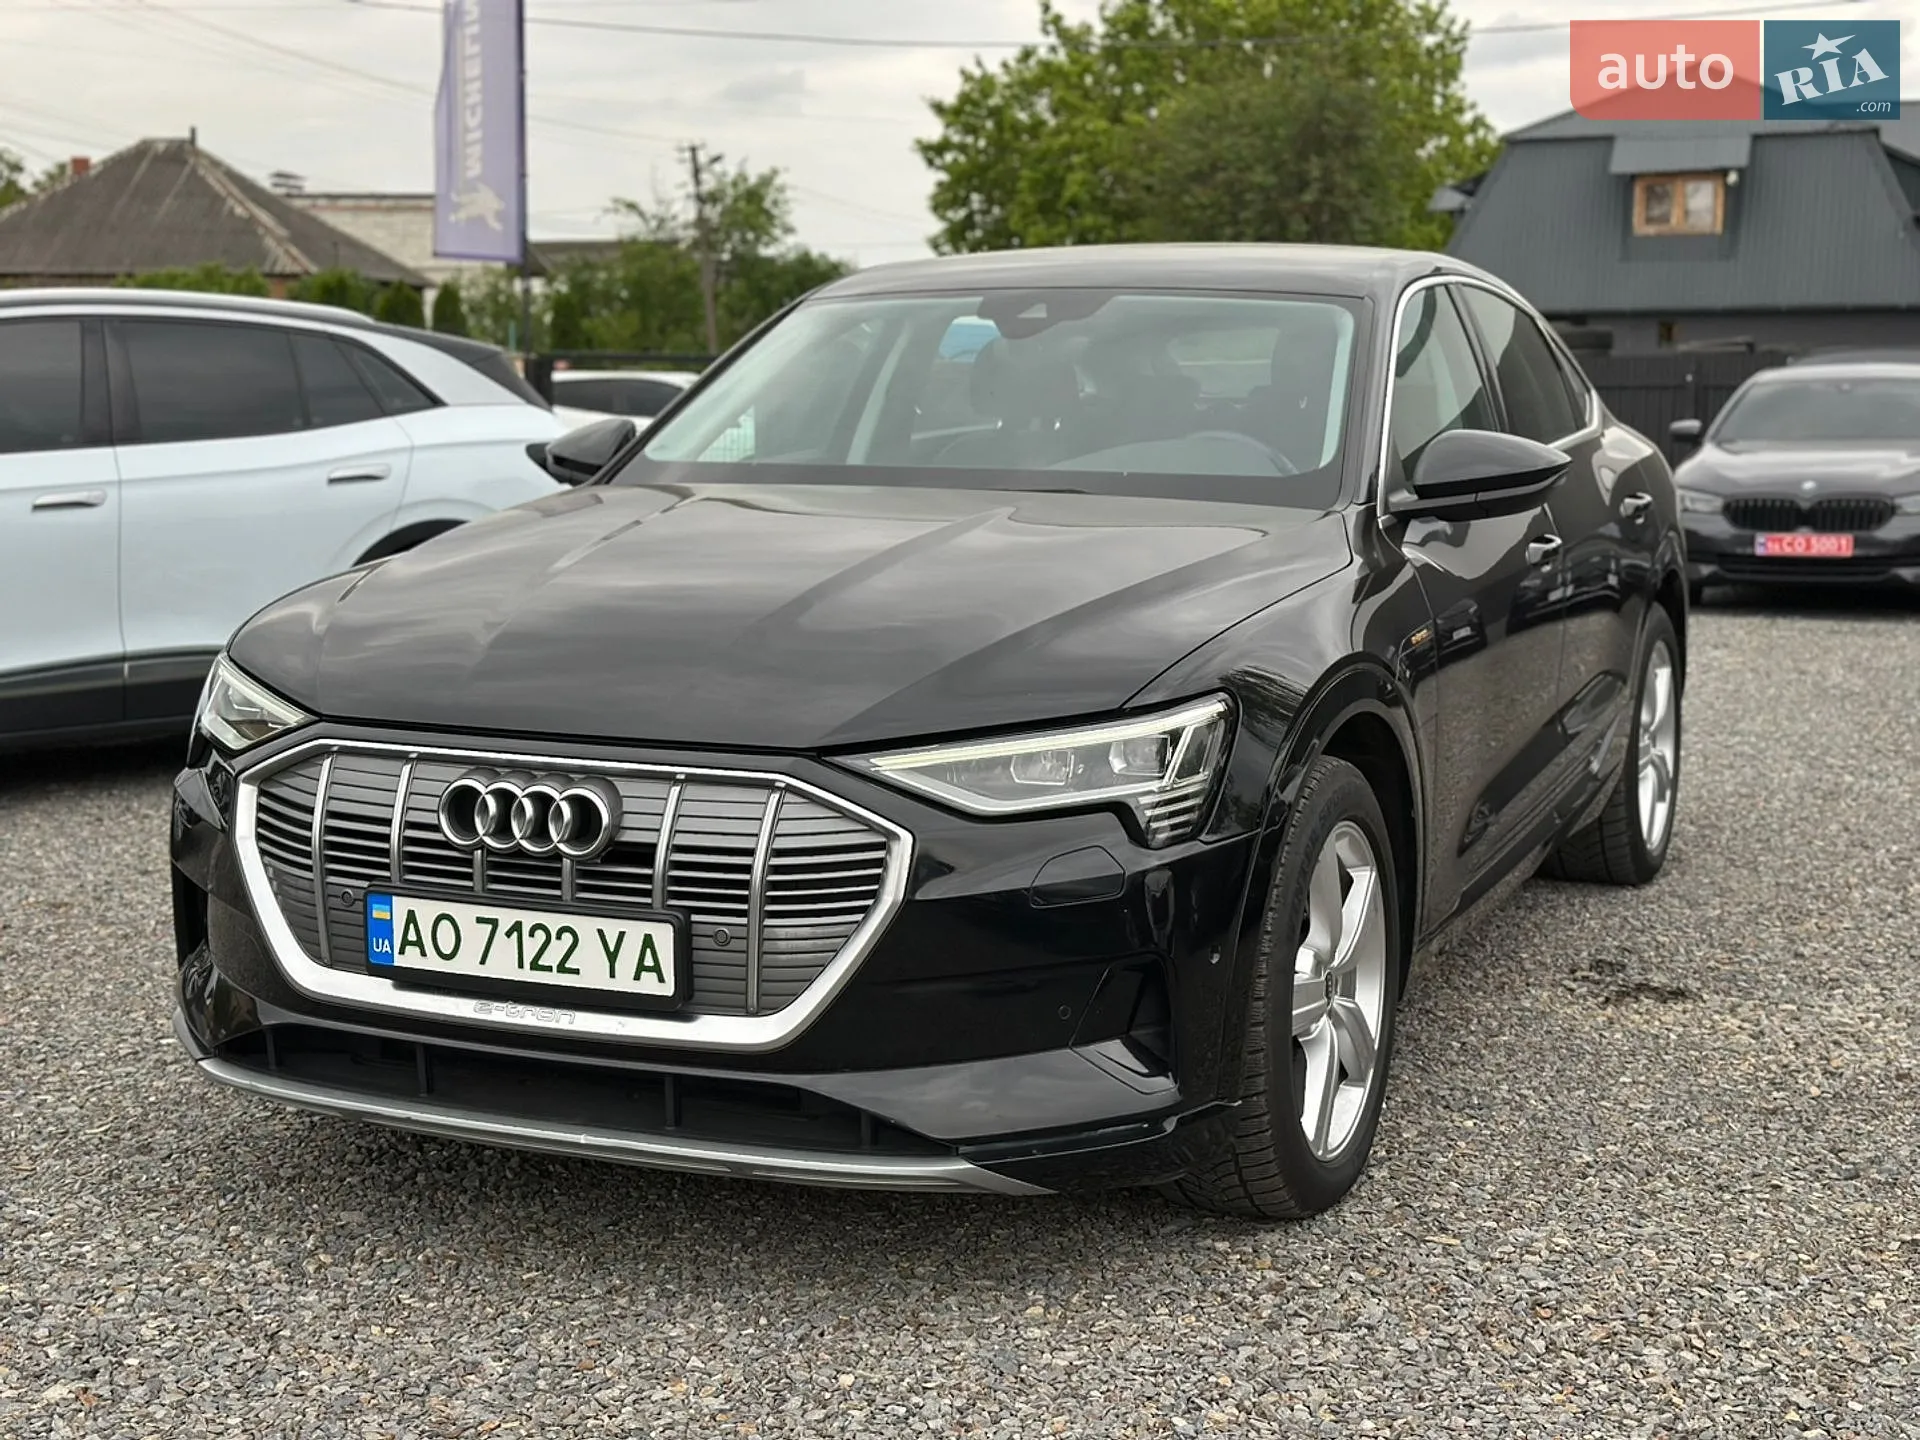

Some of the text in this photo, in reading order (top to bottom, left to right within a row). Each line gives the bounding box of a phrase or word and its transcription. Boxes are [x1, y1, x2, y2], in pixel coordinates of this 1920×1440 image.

[373, 937, 392, 955] UA
[398, 909, 666, 984] AO 7122 YA
[473, 999, 576, 1025] e-tron
